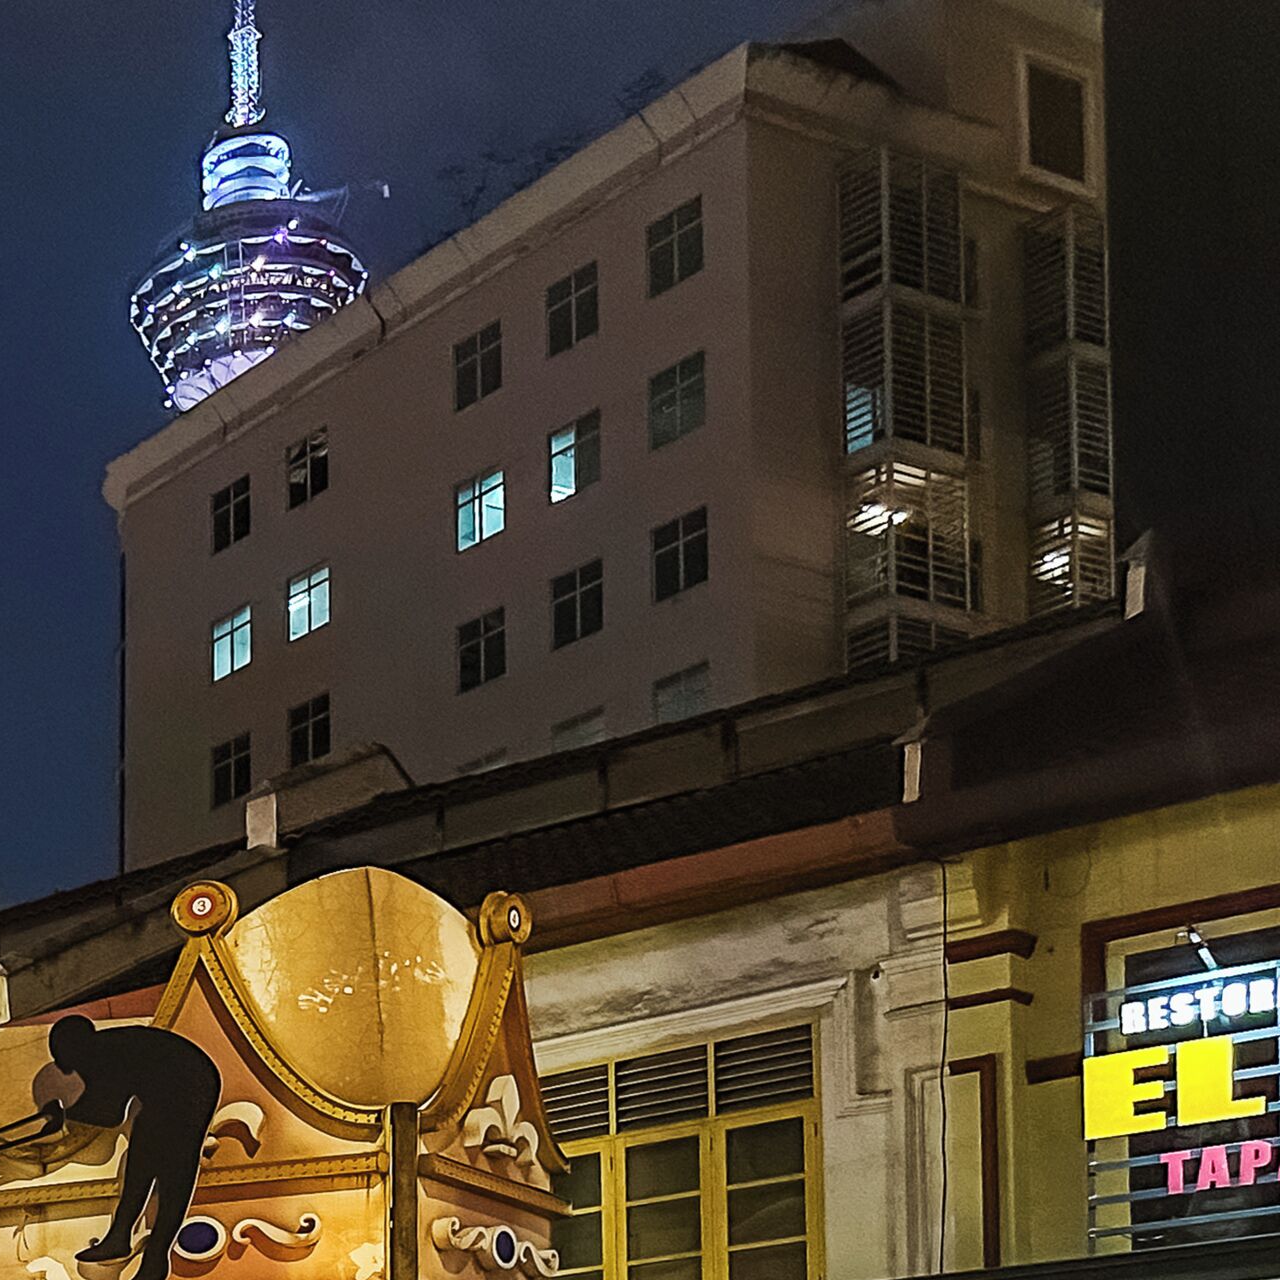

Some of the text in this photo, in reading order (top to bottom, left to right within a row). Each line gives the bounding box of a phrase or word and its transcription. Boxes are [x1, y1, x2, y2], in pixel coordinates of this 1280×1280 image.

[1121, 977, 1280, 1036] RESTOR
[1083, 1034, 1266, 1140] EL
[1160, 1139, 1280, 1195] TAP
